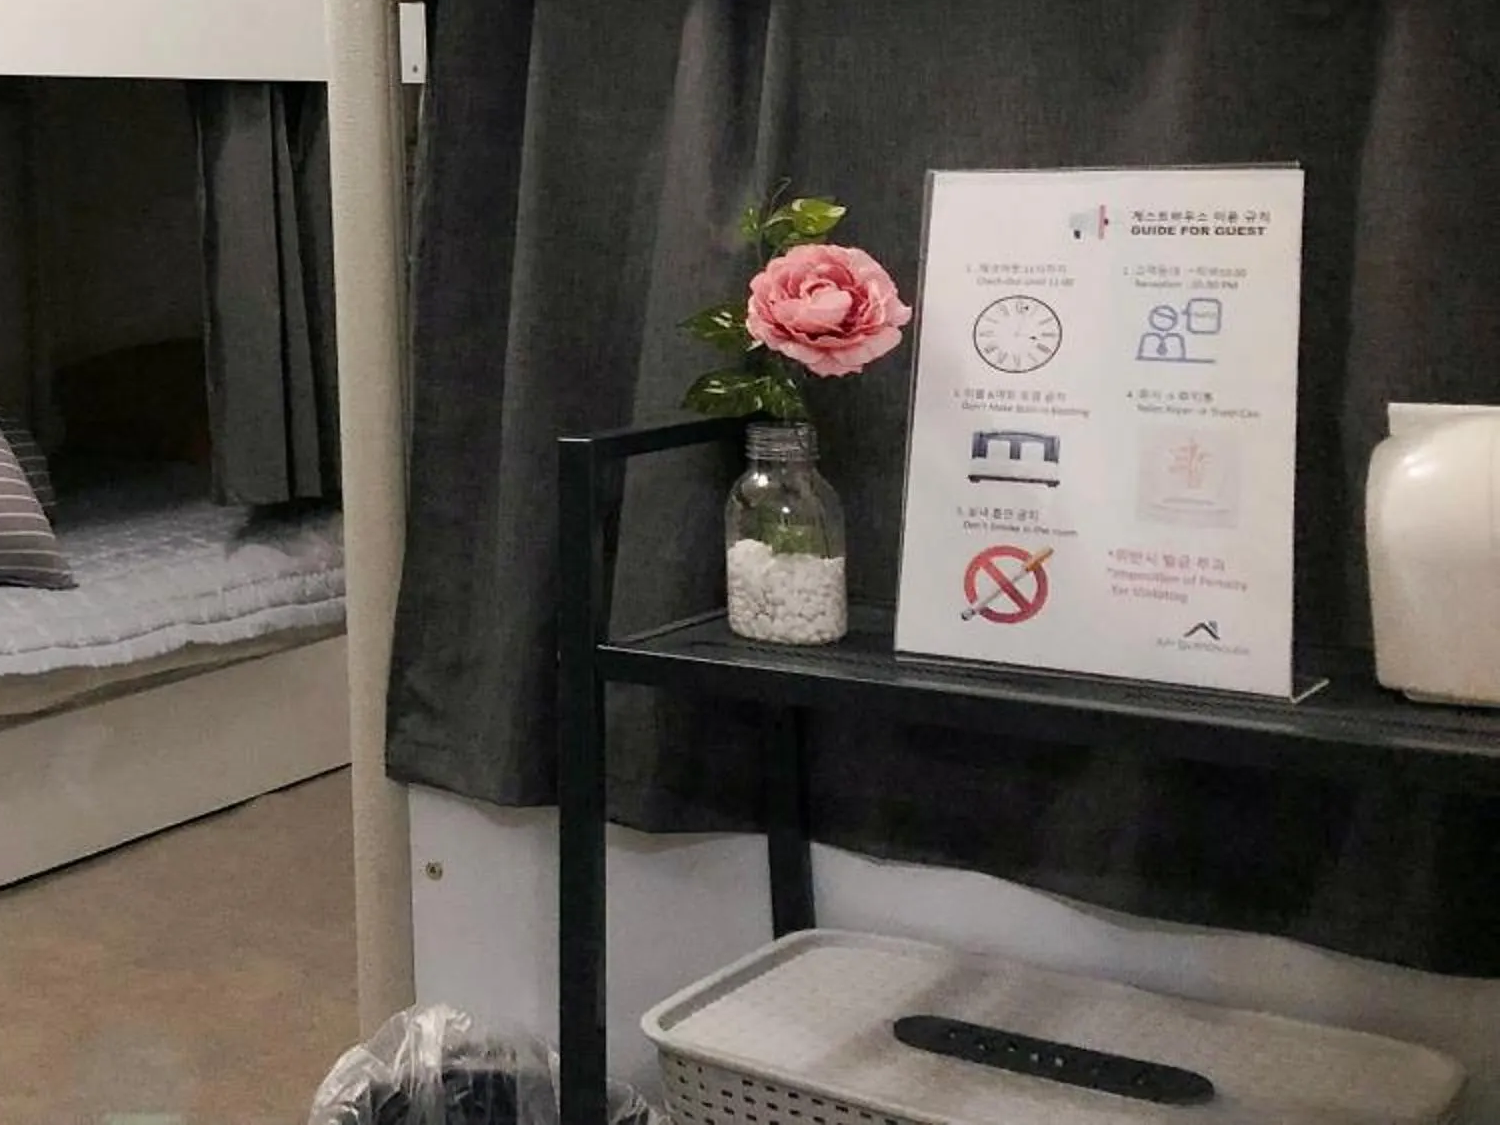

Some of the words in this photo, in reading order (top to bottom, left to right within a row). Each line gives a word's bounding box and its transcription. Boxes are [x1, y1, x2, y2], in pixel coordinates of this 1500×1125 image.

[1131, 225, 1176, 236] GUIDE
[1180, 225, 1210, 236] FOR
[1215, 226, 1267, 236] GUEST
